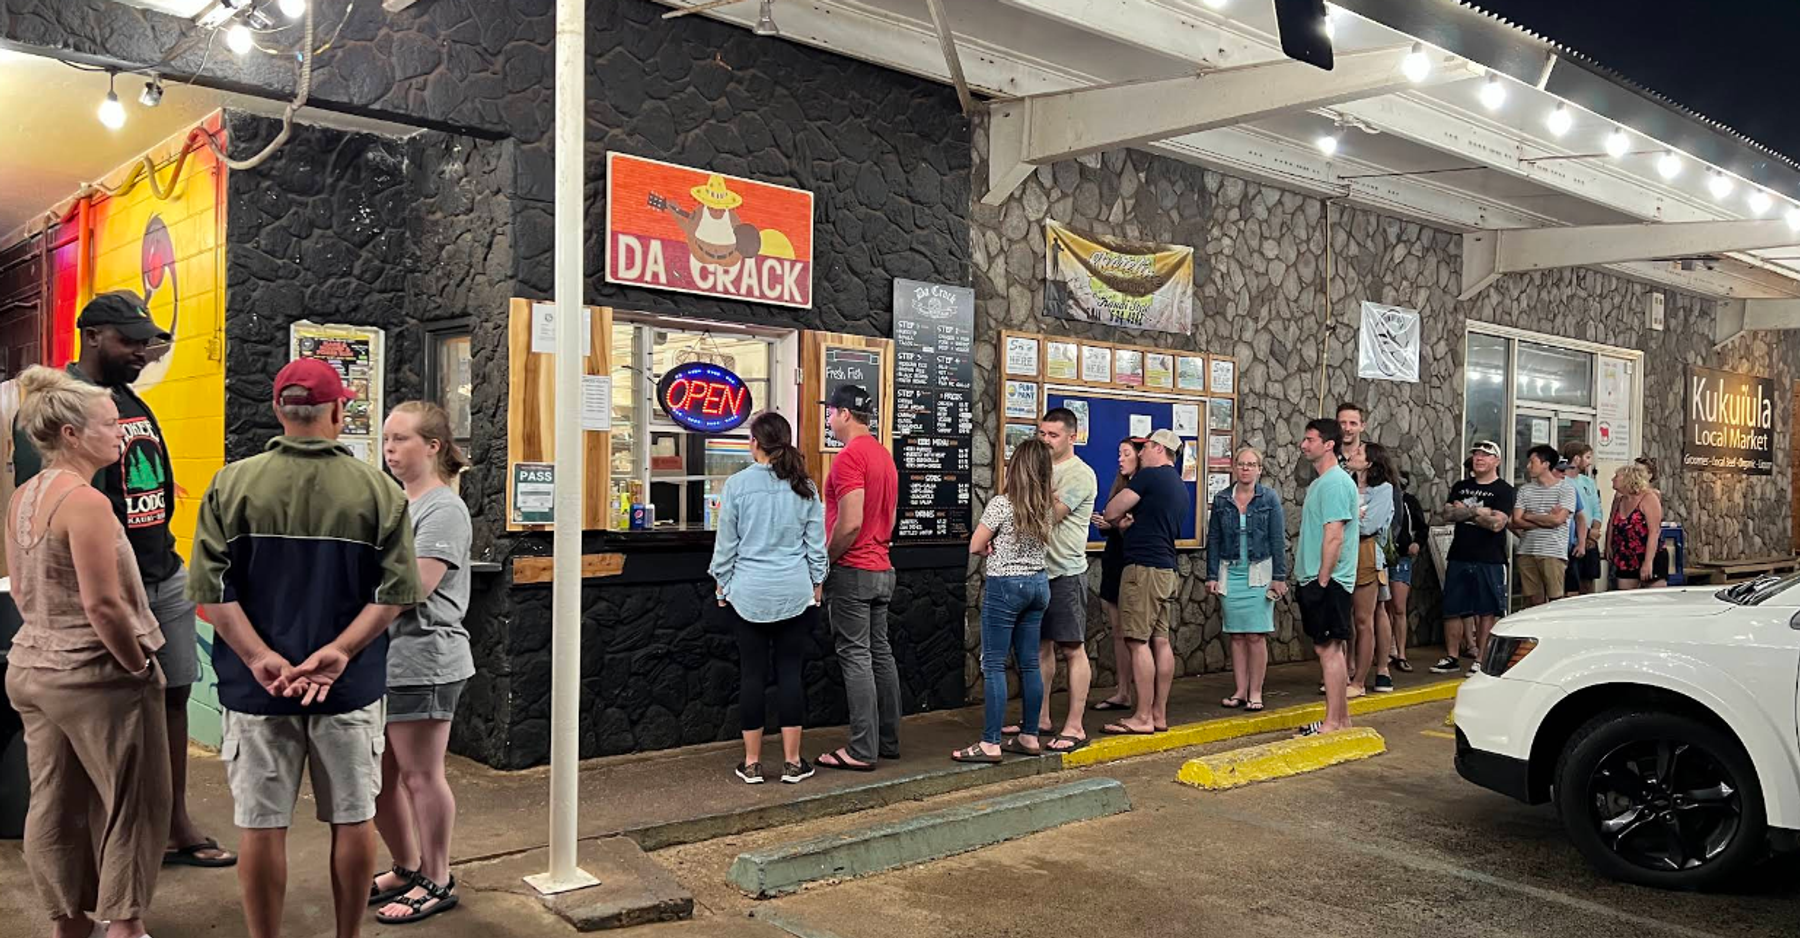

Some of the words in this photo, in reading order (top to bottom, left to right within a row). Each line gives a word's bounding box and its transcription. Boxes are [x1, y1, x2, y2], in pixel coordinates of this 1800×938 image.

[617, 233, 668, 285] DA
[689, 252, 804, 303] CRACK
[897, 320, 915, 330] STEP
[936, 325, 954, 334] STEP
[897, 352, 915, 361] STEP
[936, 356, 954, 365] STEP
[825, 366, 846, 380] Fresh
[847, 366, 864, 380] Fish
[666, 378, 747, 415] OPEN
[897, 389, 915, 398] STEP
[1695, 423, 1727, 447] Local
[1729, 427, 1768, 452] Market
[520, 470, 552, 482] PASS
